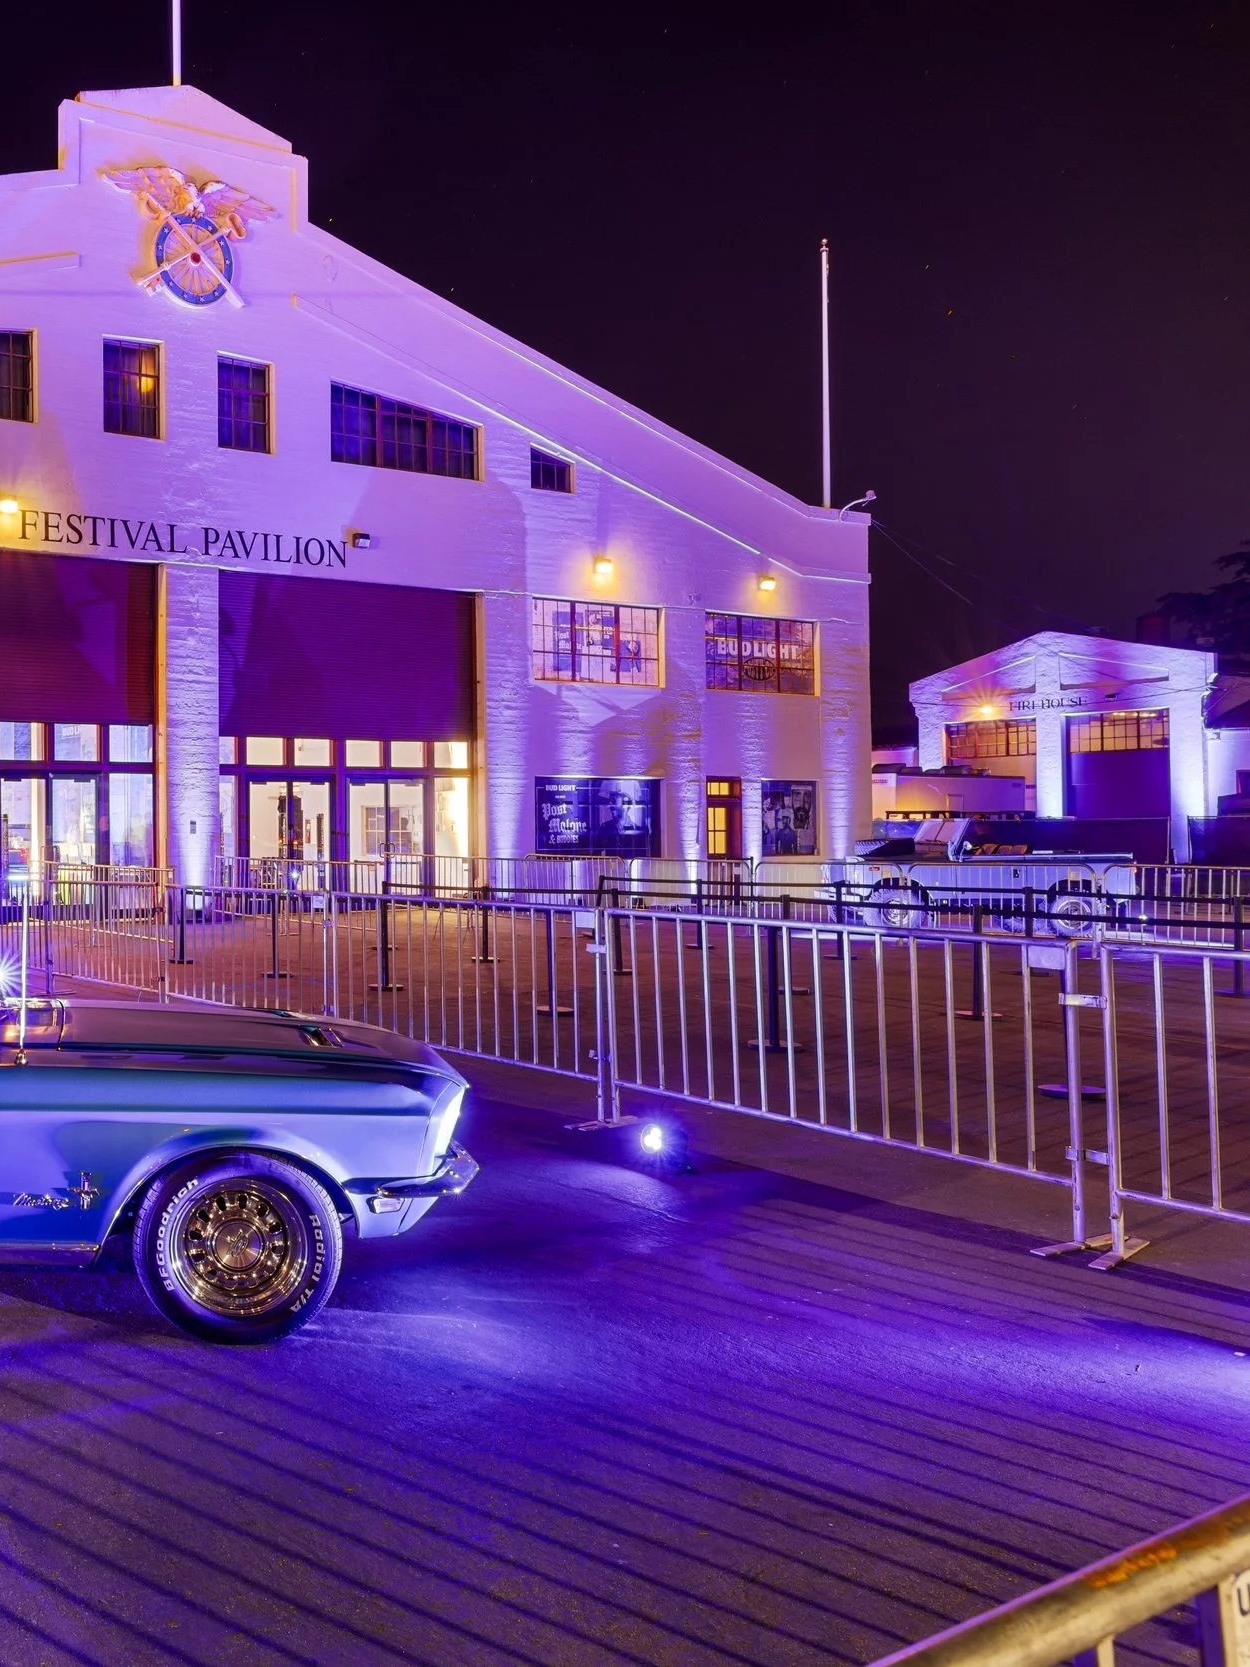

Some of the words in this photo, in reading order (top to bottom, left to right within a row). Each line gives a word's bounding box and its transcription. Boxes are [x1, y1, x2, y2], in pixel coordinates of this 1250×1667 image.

[19, 509, 188, 554] FESTIVAL
[201, 527, 347, 568] PAVILION
[718, 640, 751, 656] BUD
[753, 641, 799, 660] LIGHT
[541, 803, 567, 820] Post
[549, 819, 587, 833] Malone
[154, 1177, 200, 1292] BFGoodrich
[308, 1214, 325, 1282] Radial
[290, 1288, 315, 1313] T/A
